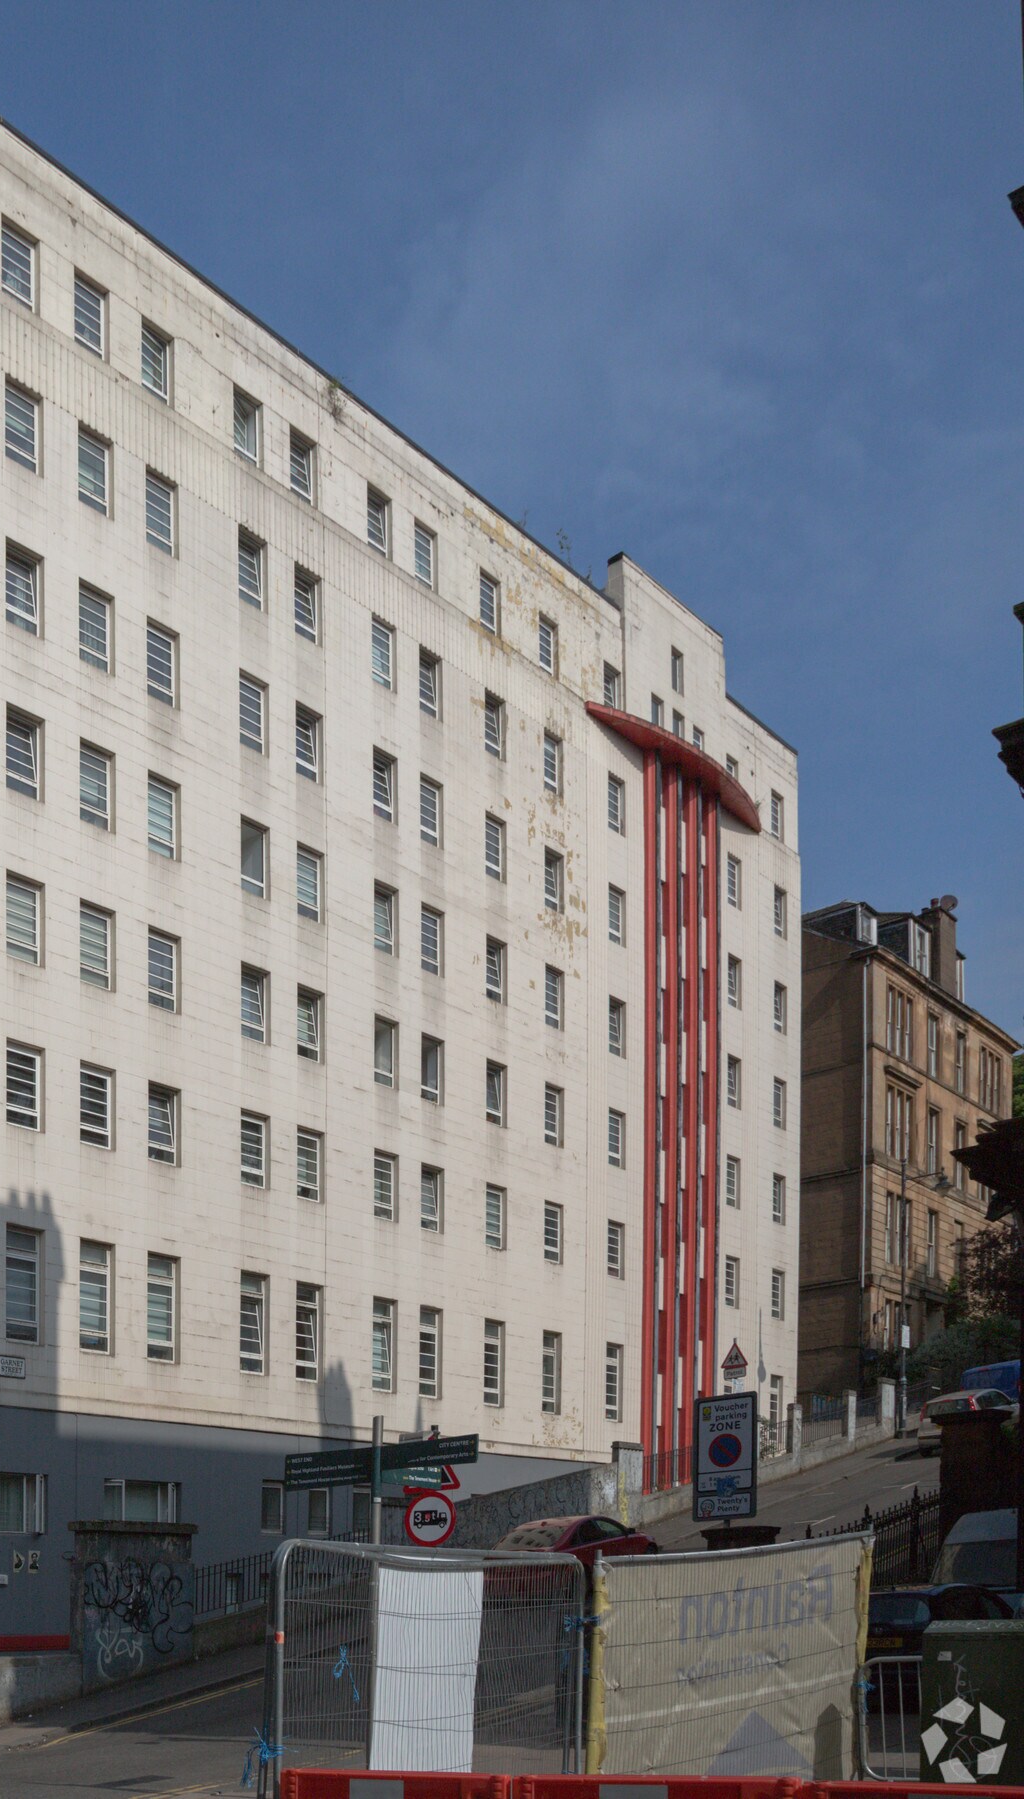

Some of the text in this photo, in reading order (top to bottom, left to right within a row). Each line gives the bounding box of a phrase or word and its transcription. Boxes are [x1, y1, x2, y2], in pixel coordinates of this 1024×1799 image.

[1, 1359, 23, 1368] GARNET
[1, 1366, 22, 1374] STREET
[714, 1402, 748, 1412] Voucher
[715, 1412, 747, 1421] parking
[709, 1420, 741, 1432] ZONE
[427, 1453, 458, 1461] Contemporary
[717, 1496, 748, 1505] Twenty's
[717, 1505, 740, 1513] Plenty
